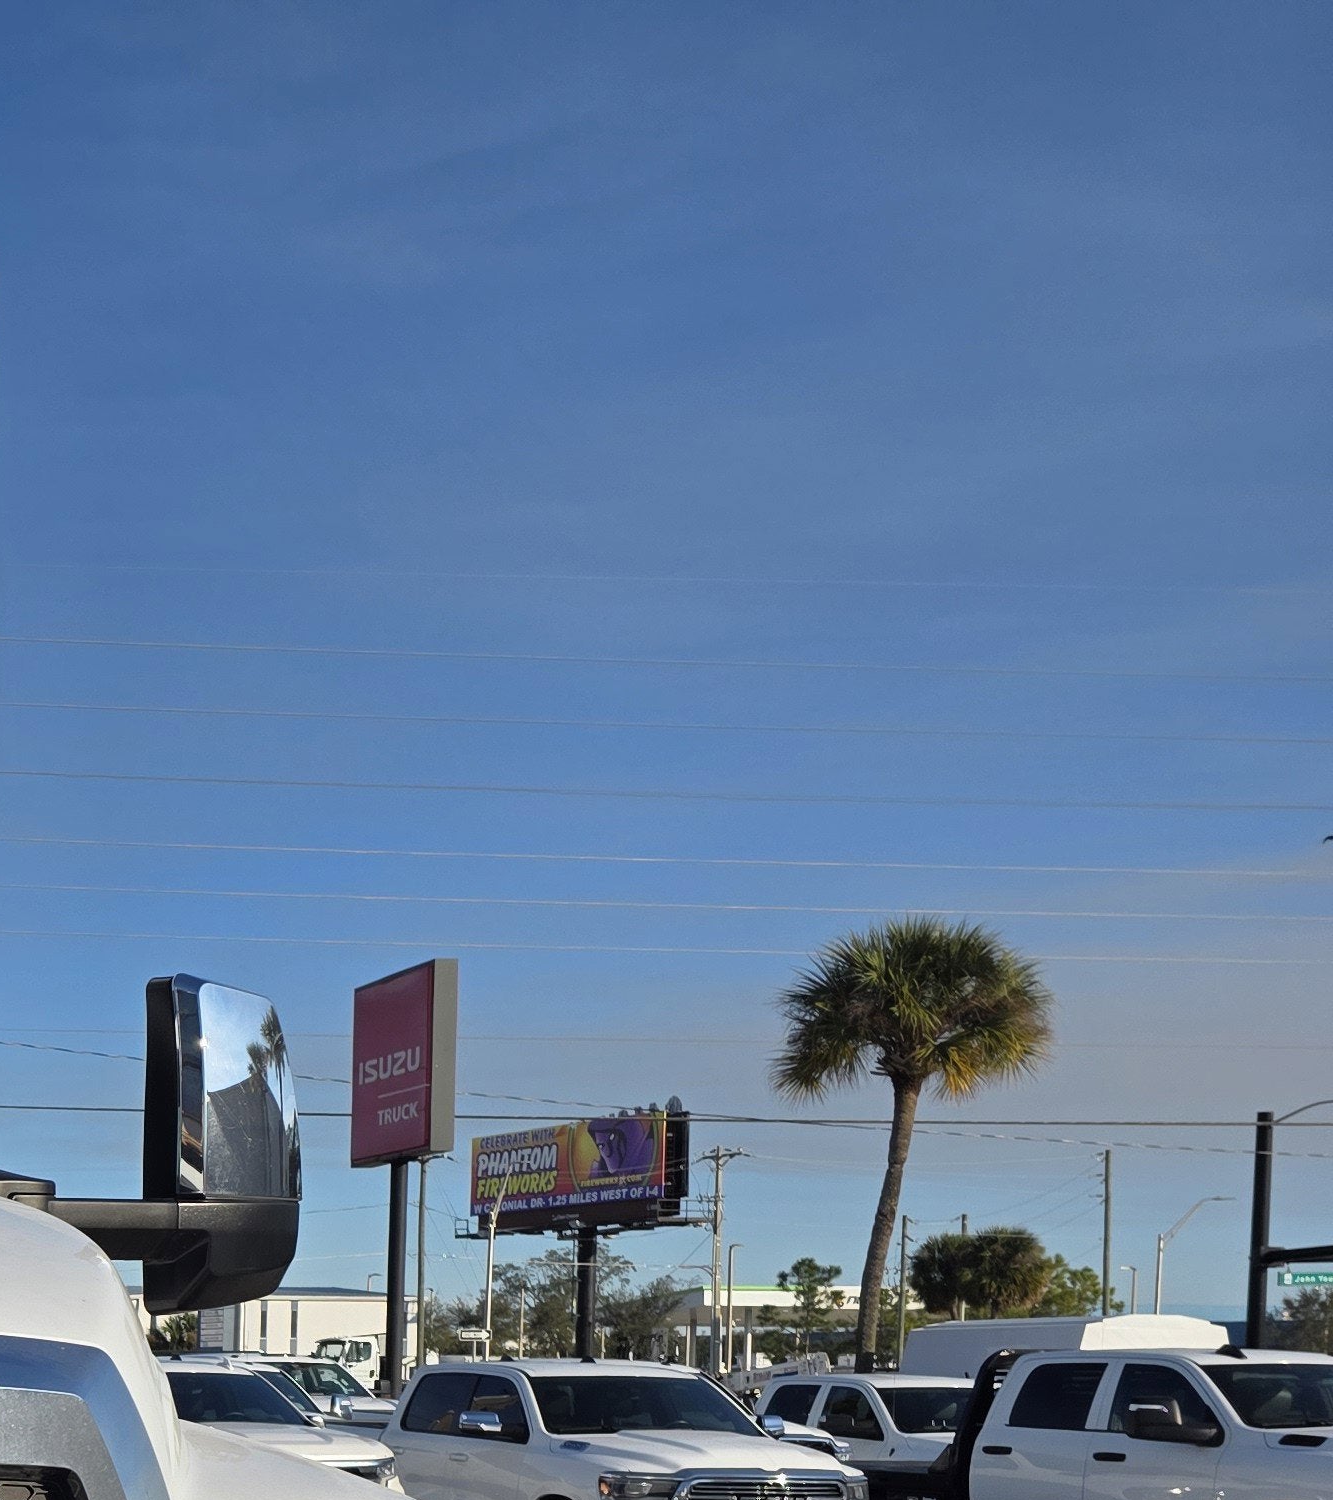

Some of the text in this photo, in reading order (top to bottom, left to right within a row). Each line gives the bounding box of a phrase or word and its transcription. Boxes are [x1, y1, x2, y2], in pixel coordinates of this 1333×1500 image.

[358, 1046, 420, 1085] ISUZU
[377, 1101, 419, 1126] TRUCK
[480, 1128, 555, 1150] CELEBRATE WITH
[477, 1145, 558, 1177] PHANTOM
[474, 1204, 482, 1214] W
[483, 1200, 528, 1214] CONIAL
[548, 1196, 567, 1206] 1.25
[569, 1191, 598, 1205] MILES
[600, 1189, 628, 1201] WEST
[630, 1187, 643, 1198] OF
[646, 1186, 659, 1197] I-4
